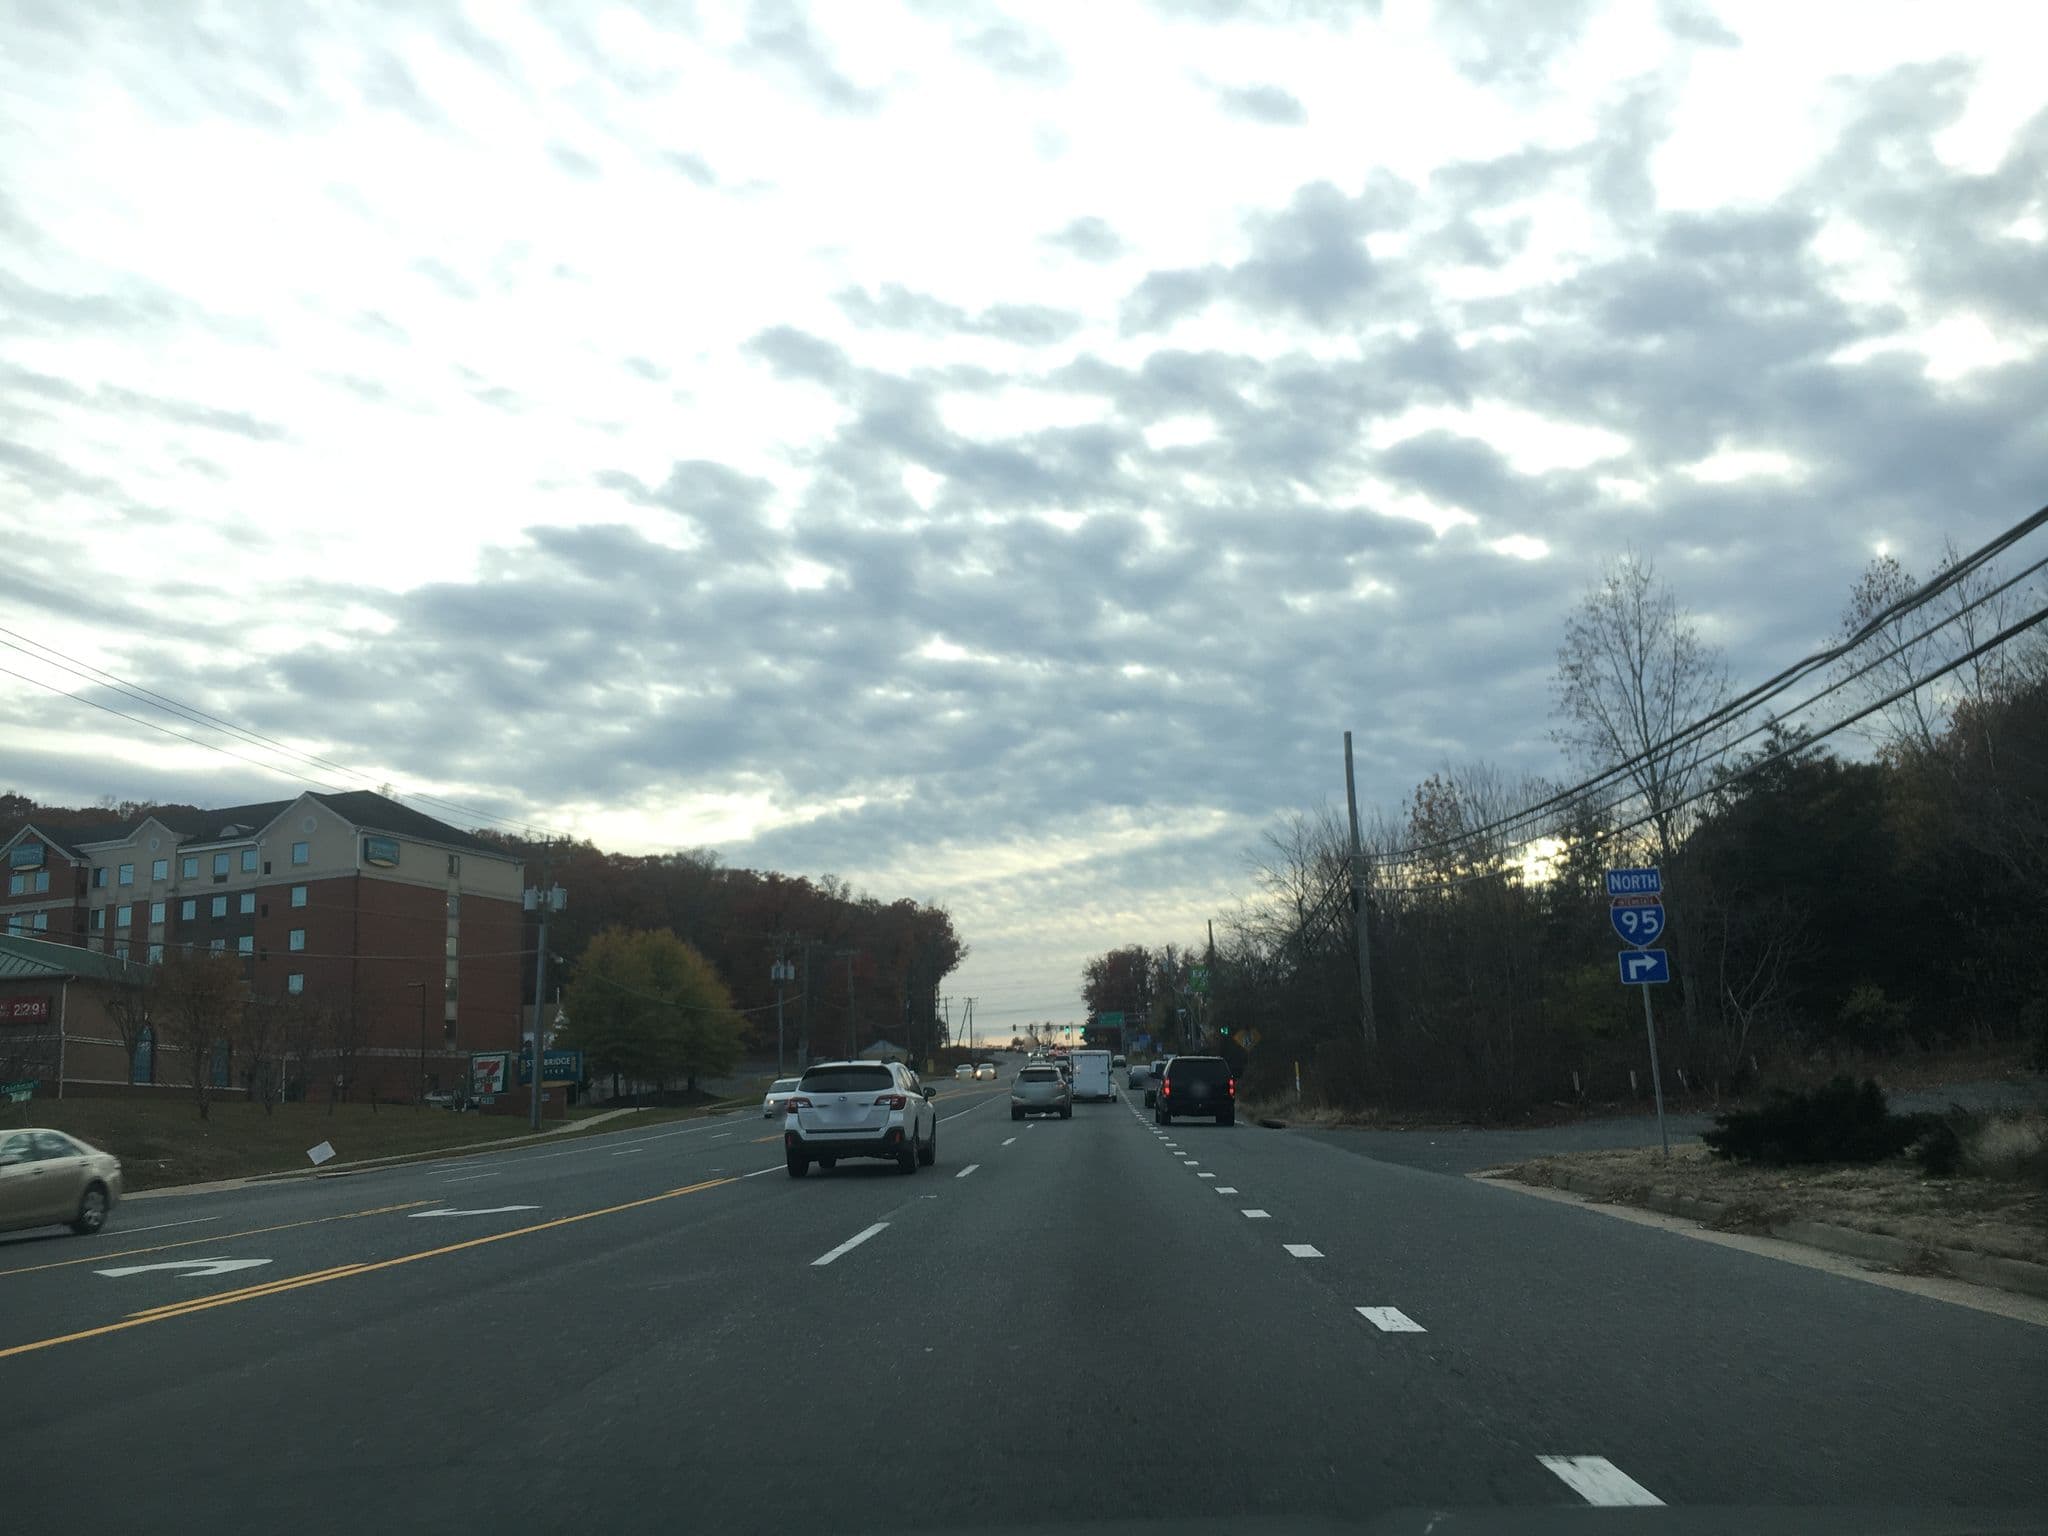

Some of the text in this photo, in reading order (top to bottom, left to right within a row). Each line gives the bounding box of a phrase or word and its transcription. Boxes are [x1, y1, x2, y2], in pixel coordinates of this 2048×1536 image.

[1610, 873, 1658, 890] NORTH
[1621, 909, 1659, 934] 95
[527, 1056, 571, 1067] STBRIDGE
